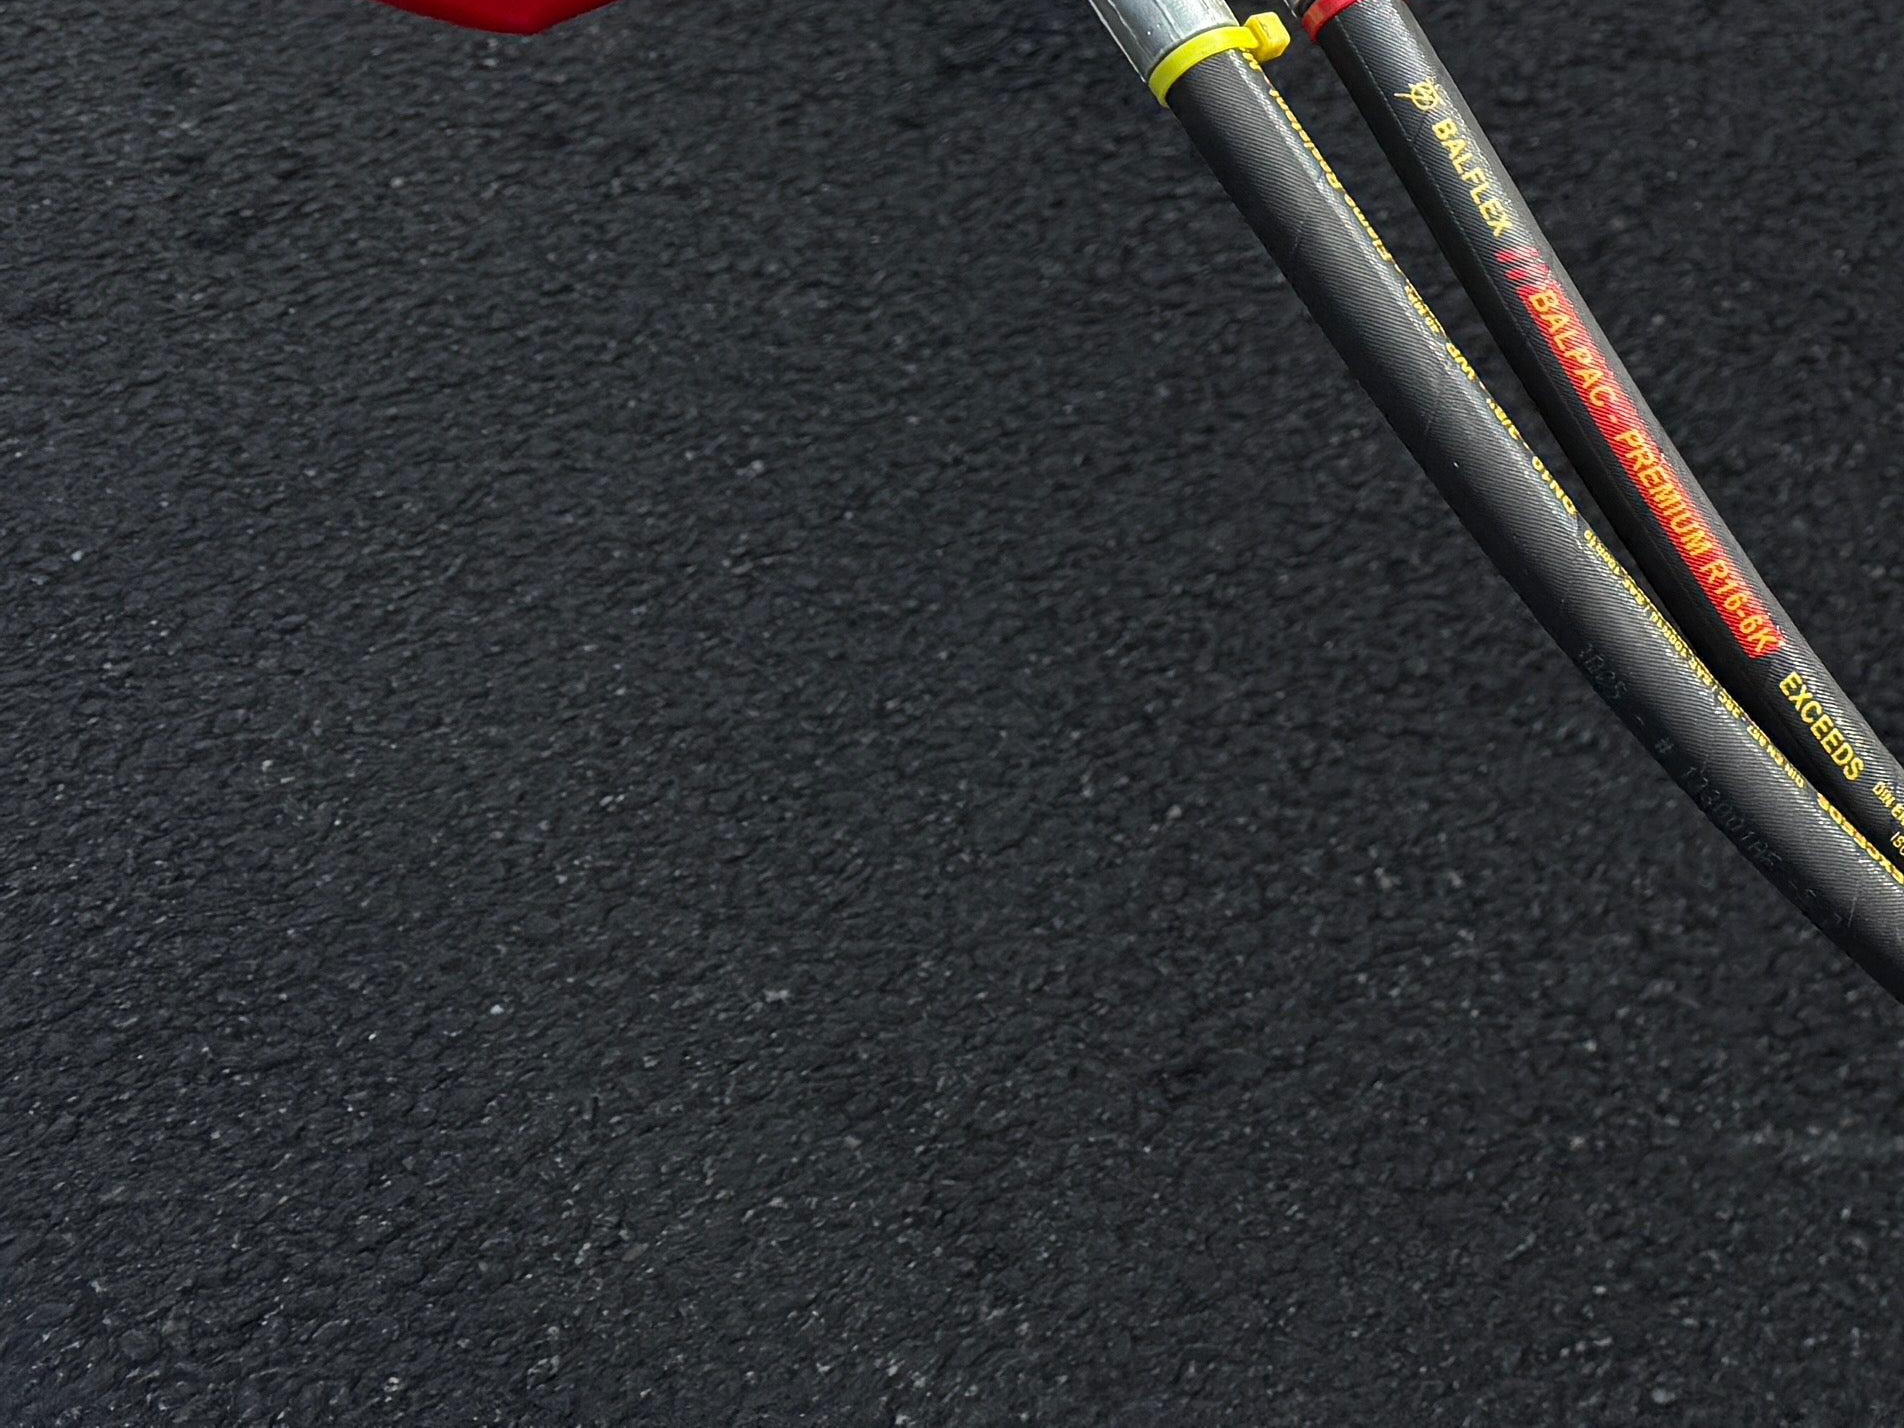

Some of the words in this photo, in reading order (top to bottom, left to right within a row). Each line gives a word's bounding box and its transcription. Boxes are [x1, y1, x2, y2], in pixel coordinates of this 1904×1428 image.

[1430, 116, 1513, 237] BALFLEX
[1528, 288, 1618, 411] BALPAC
[1616, 426, 1715, 558] PREMIUM
[1700, 558, 1784, 654] R16-6K
[1778, 670, 1864, 782] EXCEEDS
[1870, 780, 1897, 809] DIN
